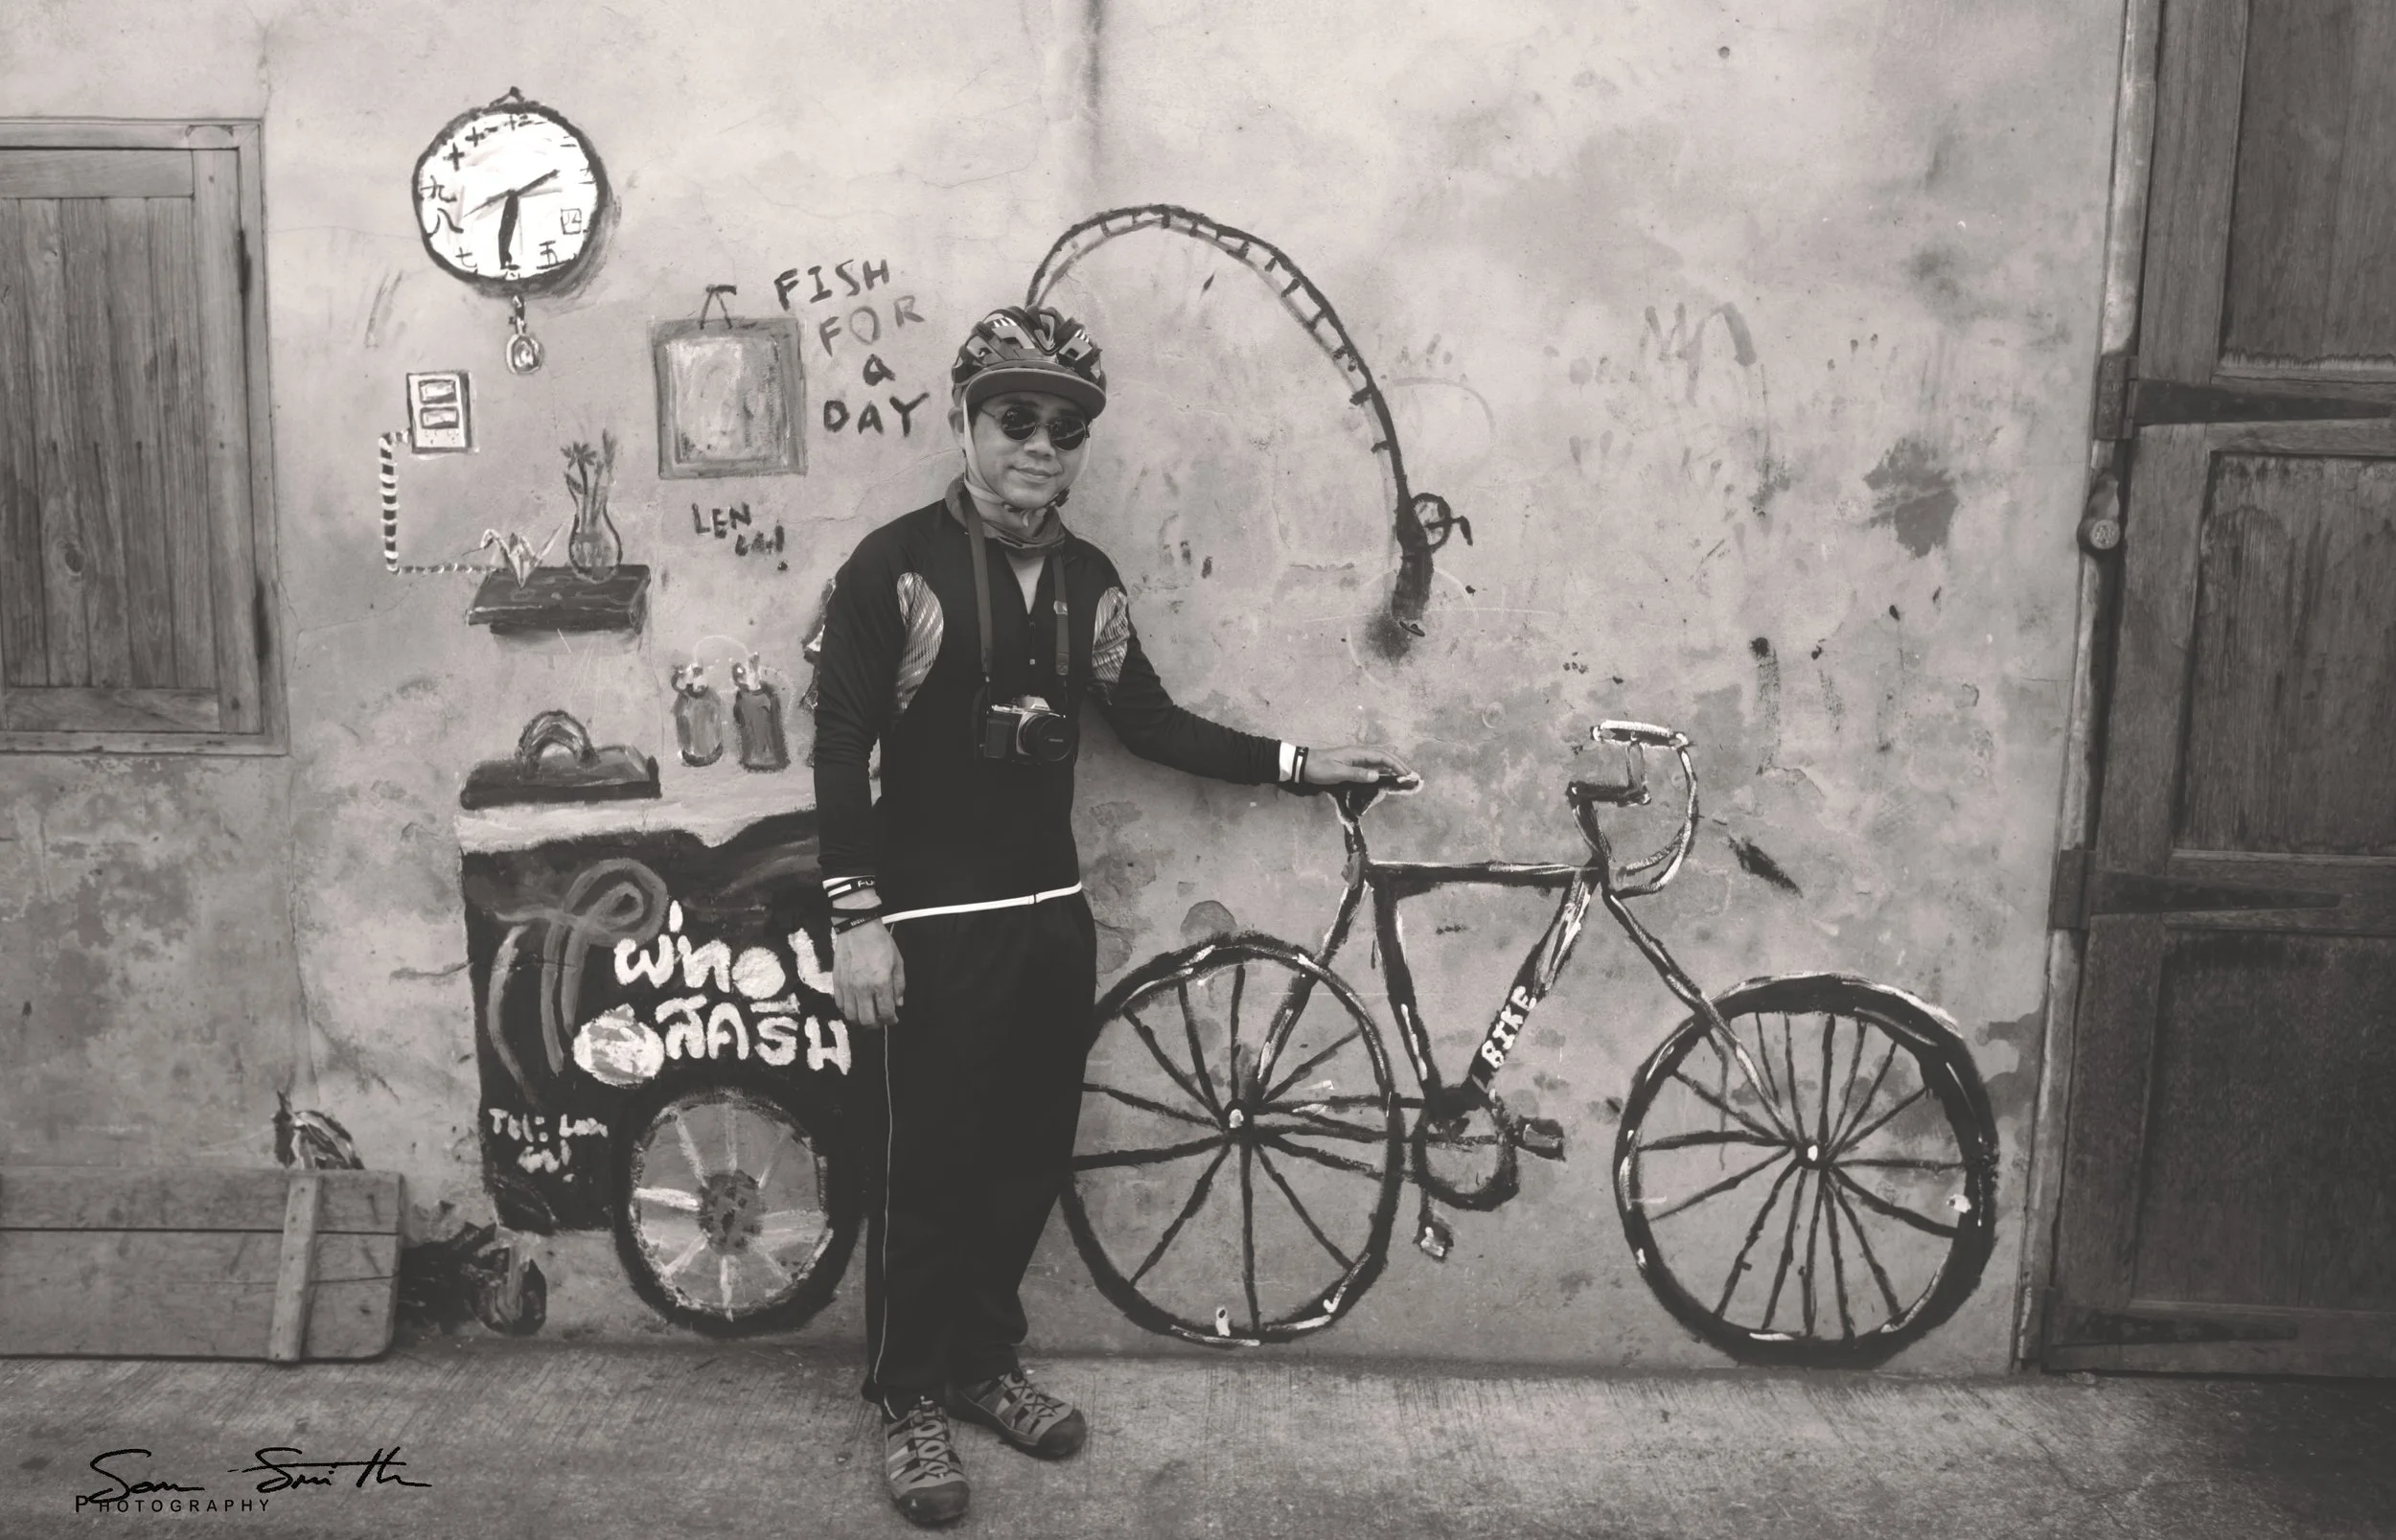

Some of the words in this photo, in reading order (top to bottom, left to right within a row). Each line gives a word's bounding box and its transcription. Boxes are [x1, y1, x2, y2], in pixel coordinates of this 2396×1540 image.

[773, 258, 890, 311] FISH
[818, 294, 926, 357] FOR
[822, 391, 931, 437] DAY
[691, 501, 752, 540] LEN
[1481, 985, 1537, 1069] BIKE
